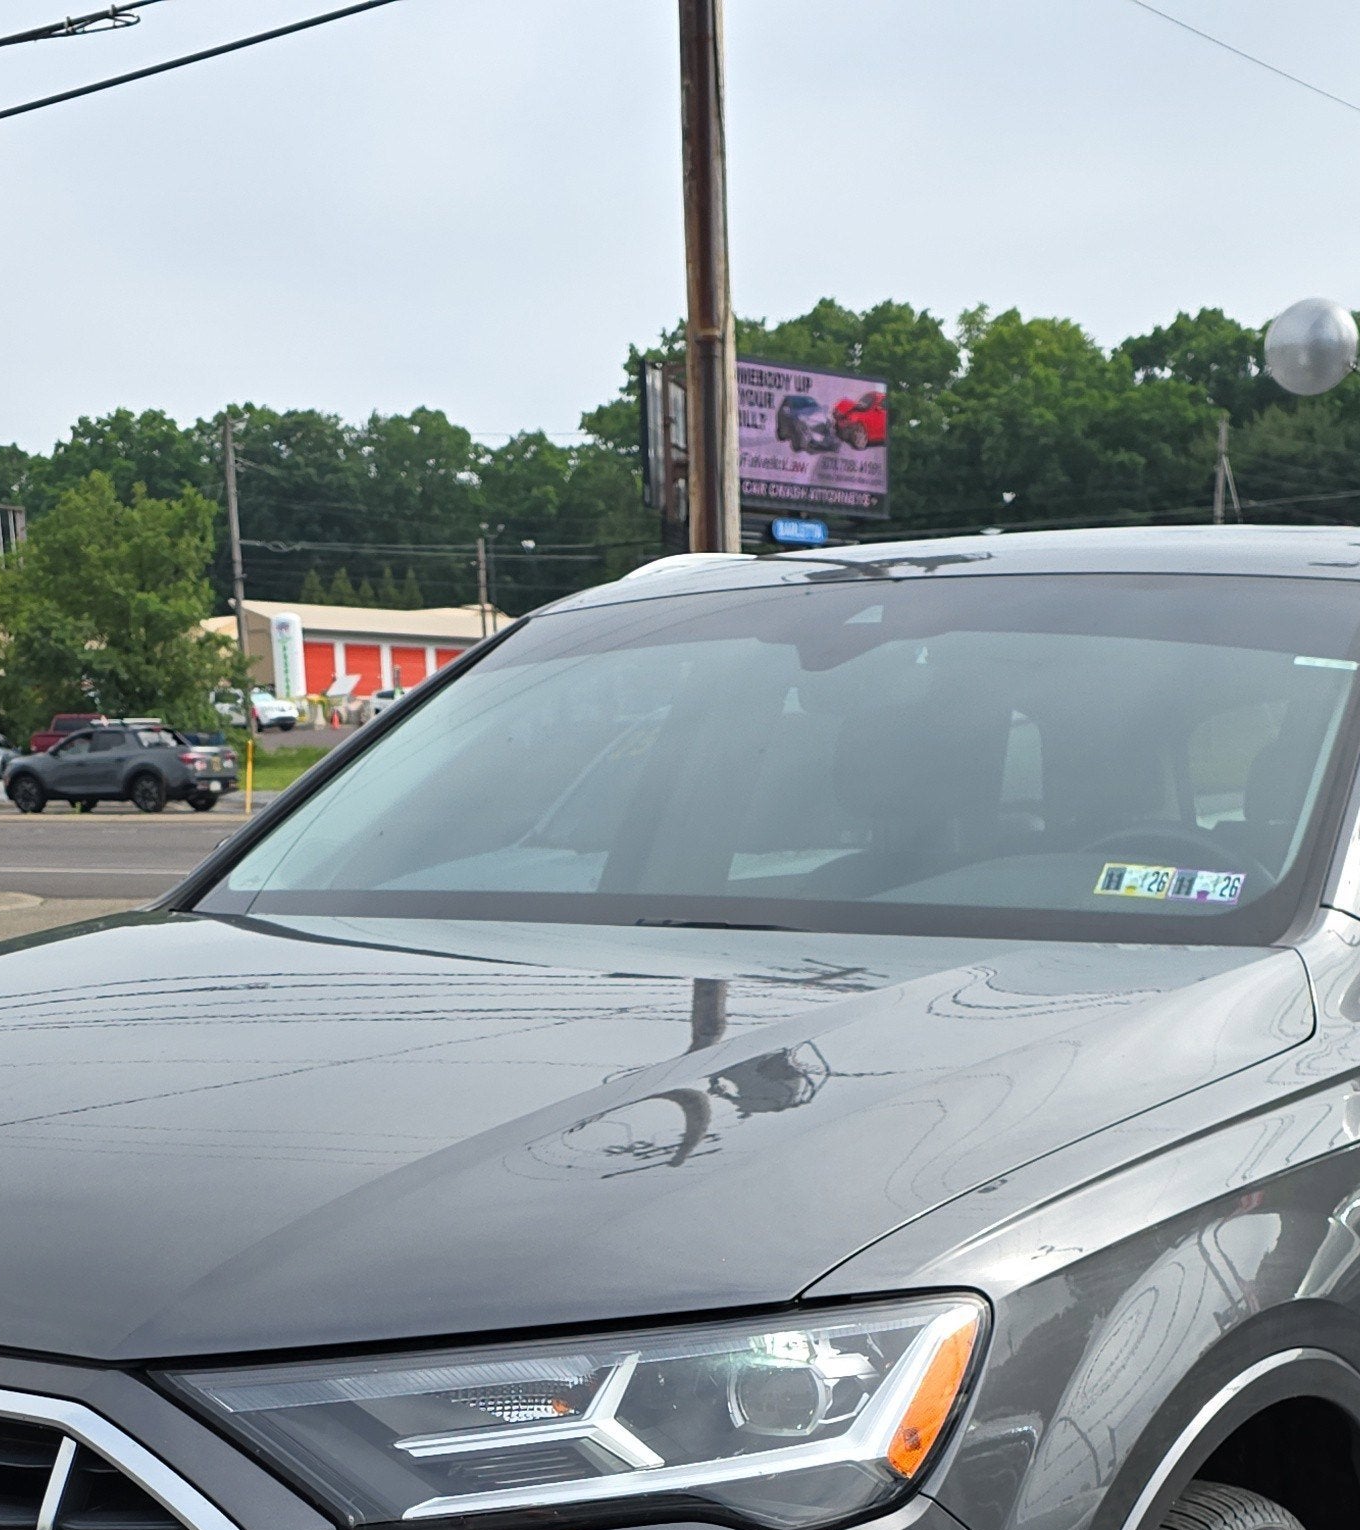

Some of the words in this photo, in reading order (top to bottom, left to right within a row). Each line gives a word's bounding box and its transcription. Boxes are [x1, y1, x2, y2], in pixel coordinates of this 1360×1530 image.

[794, 375, 814, 393] UP
[741, 479, 767, 496] CAR
[1147, 870, 1169, 893] 26
[1219, 876, 1241, 898] 26
